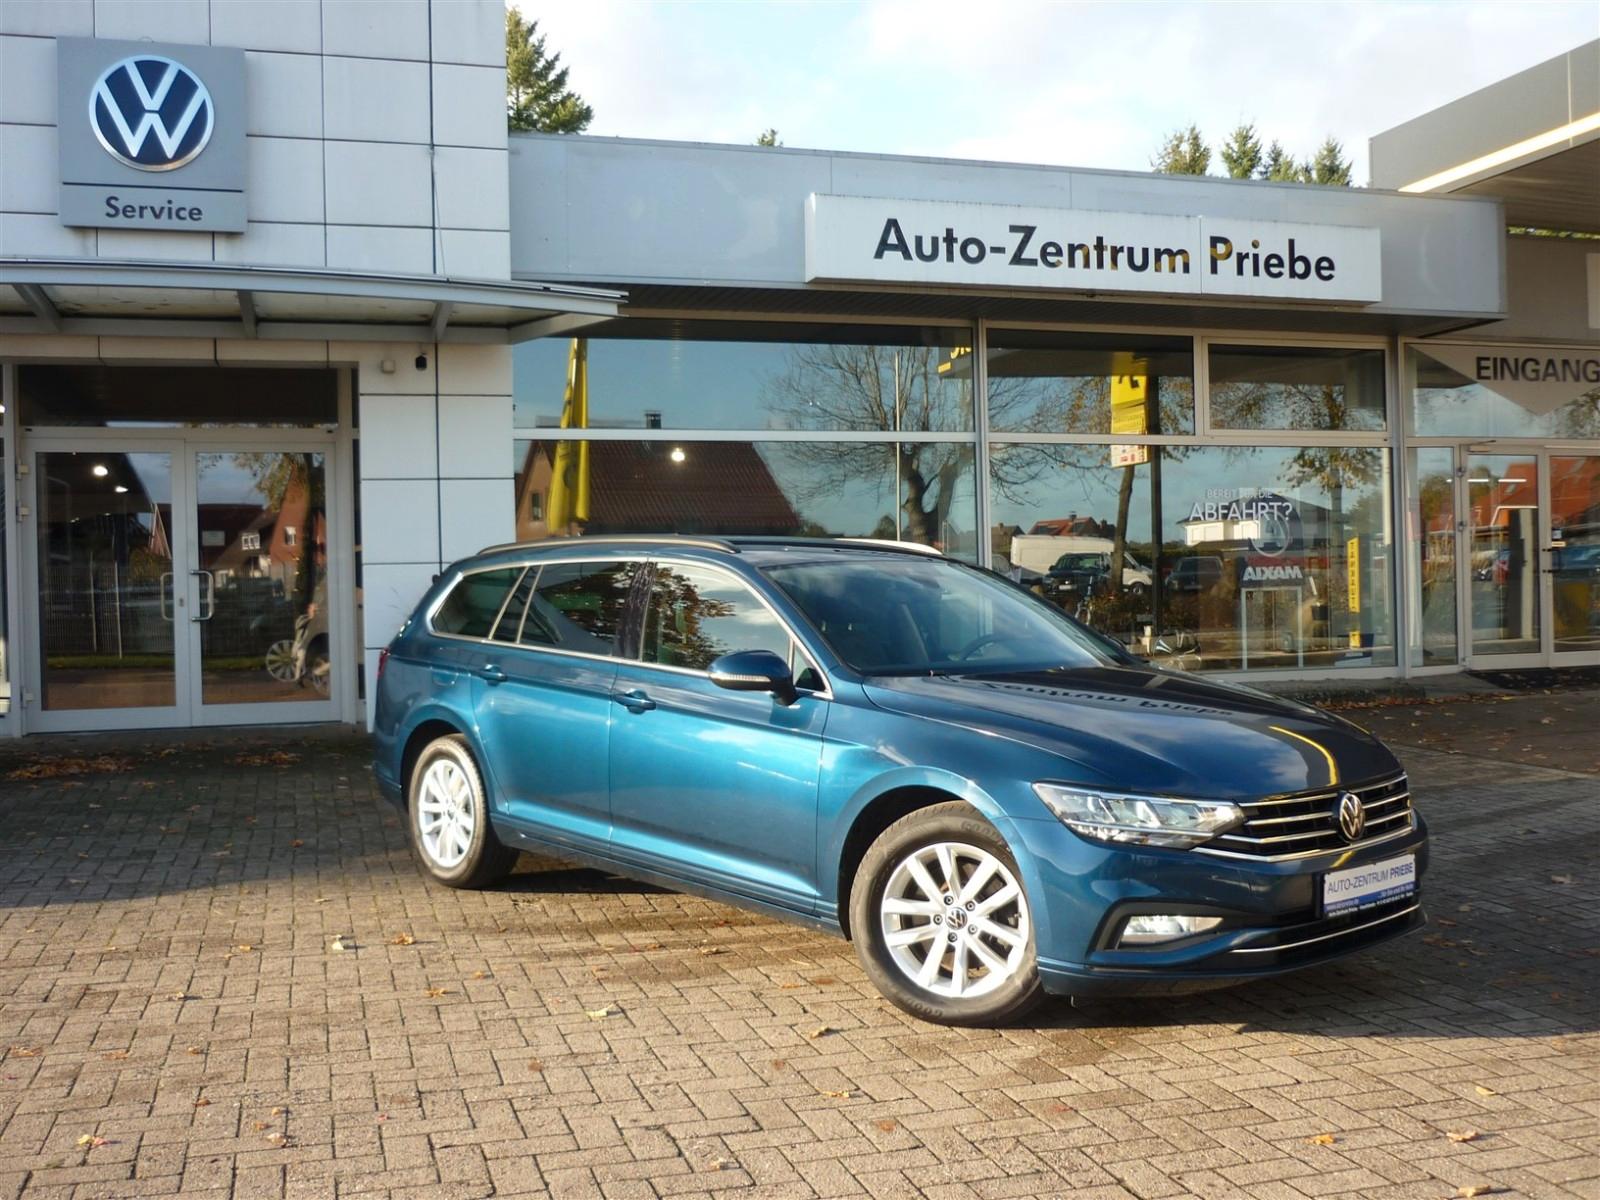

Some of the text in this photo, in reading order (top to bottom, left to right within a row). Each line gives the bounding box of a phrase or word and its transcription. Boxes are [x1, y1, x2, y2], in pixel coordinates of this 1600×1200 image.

[105, 195, 203, 222] Service
[873, 217, 1336, 282] Auto-Zentrum Priebe
[1476, 356, 1600, 383] EINGANG
[1189, 502, 1292, 520] ABFAHRT?
[1242, 565, 1303, 581] AIXAM
[1328, 870, 1389, 893] AUTO-ZENTRUM
[1390, 863, 1413, 879] PRIEBE
